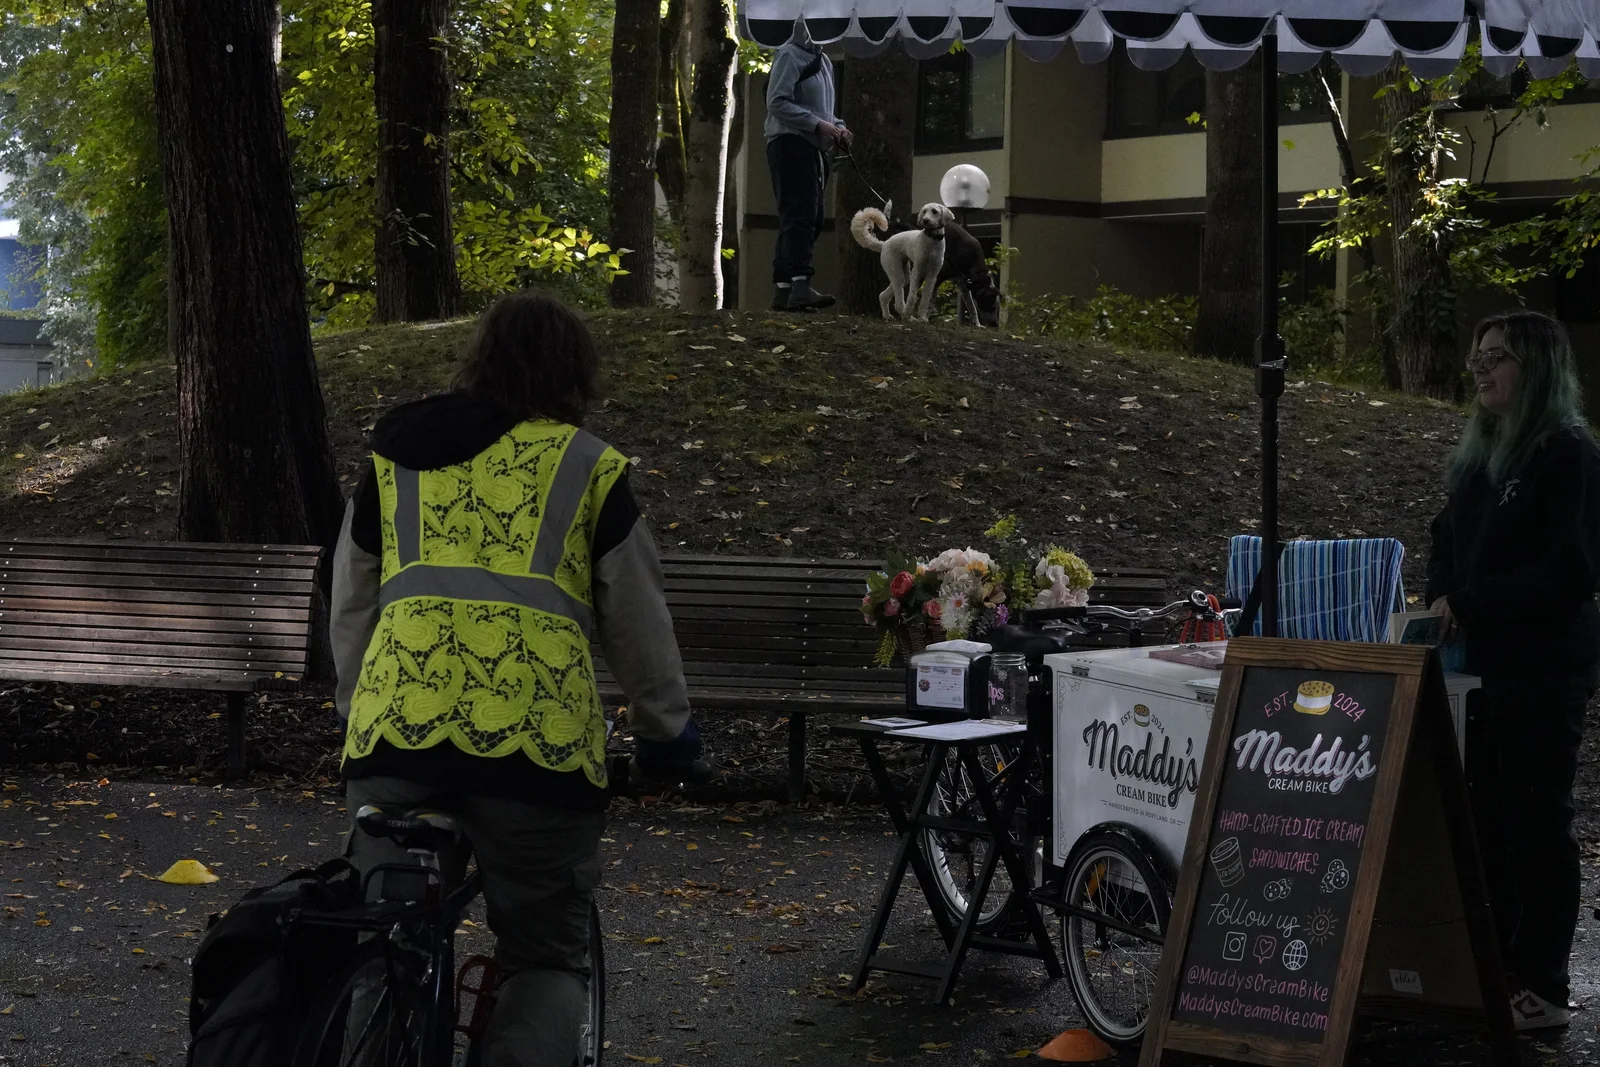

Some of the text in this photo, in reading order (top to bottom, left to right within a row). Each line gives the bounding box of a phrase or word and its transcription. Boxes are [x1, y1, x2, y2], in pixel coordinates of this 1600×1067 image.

[1120, 711, 1165, 734] EST. 2024
[1263, 690, 1367, 723] EST. 2024
[1082, 718, 1198, 810] Maddy's
[1233, 728, 1377, 795] Maddy's
[1116, 783, 1167, 808] CREAM BIKE
[1268, 777, 1329, 794] CREAM BIKE
[1108, 802, 1140, 815] HANDCRAFTED
[1219, 809, 1365, 848] HAND-CRAFTED ICE CREAM
[1249, 847, 1320, 875] SANDWICHES
[1207, 893, 1301, 938] follow us
[1186, 965, 1329, 1002] @MaddysCreamBike
[1178, 992, 1329, 1031] MaddysCreamBike.com
